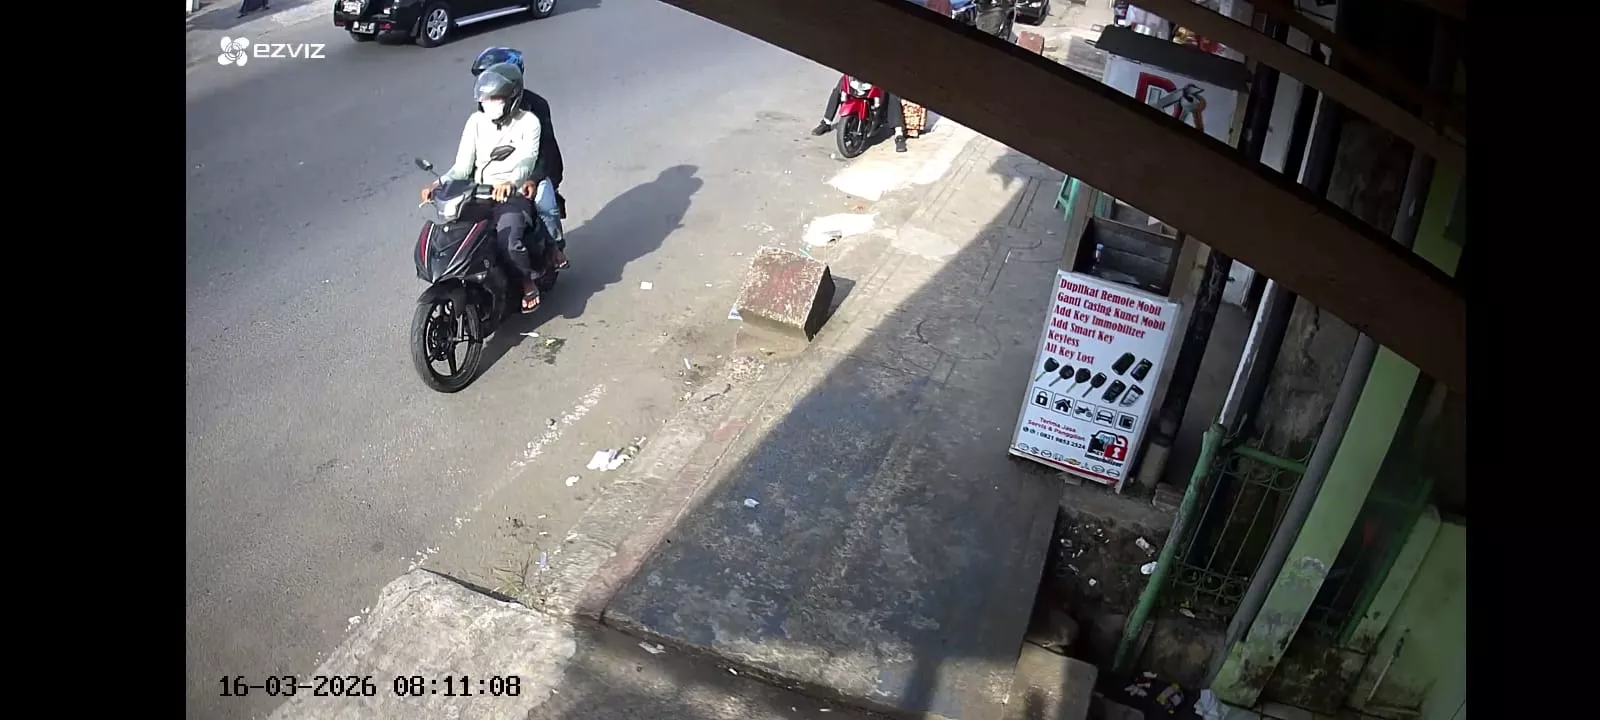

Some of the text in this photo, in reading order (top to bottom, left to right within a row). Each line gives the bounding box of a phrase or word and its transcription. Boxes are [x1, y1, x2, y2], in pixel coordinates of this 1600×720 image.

[1060, 278, 1162, 315] Duplikat Remote Mobil
[1054, 305, 1146, 339] Add Key Immobilizer
[1057, 291, 1166, 331] Ganti Casing Kunci Mobil
[1048, 329, 1080, 347] Keyless
[1051, 317, 1114, 344] Add Smart Key
[1045, 342, 1094, 365] All Key Lost
[1027, 419, 1047, 431] Servis
[1053, 427, 1086, 441] Panggilan
[1040, 417, 1077, 433] Terima Jasa
